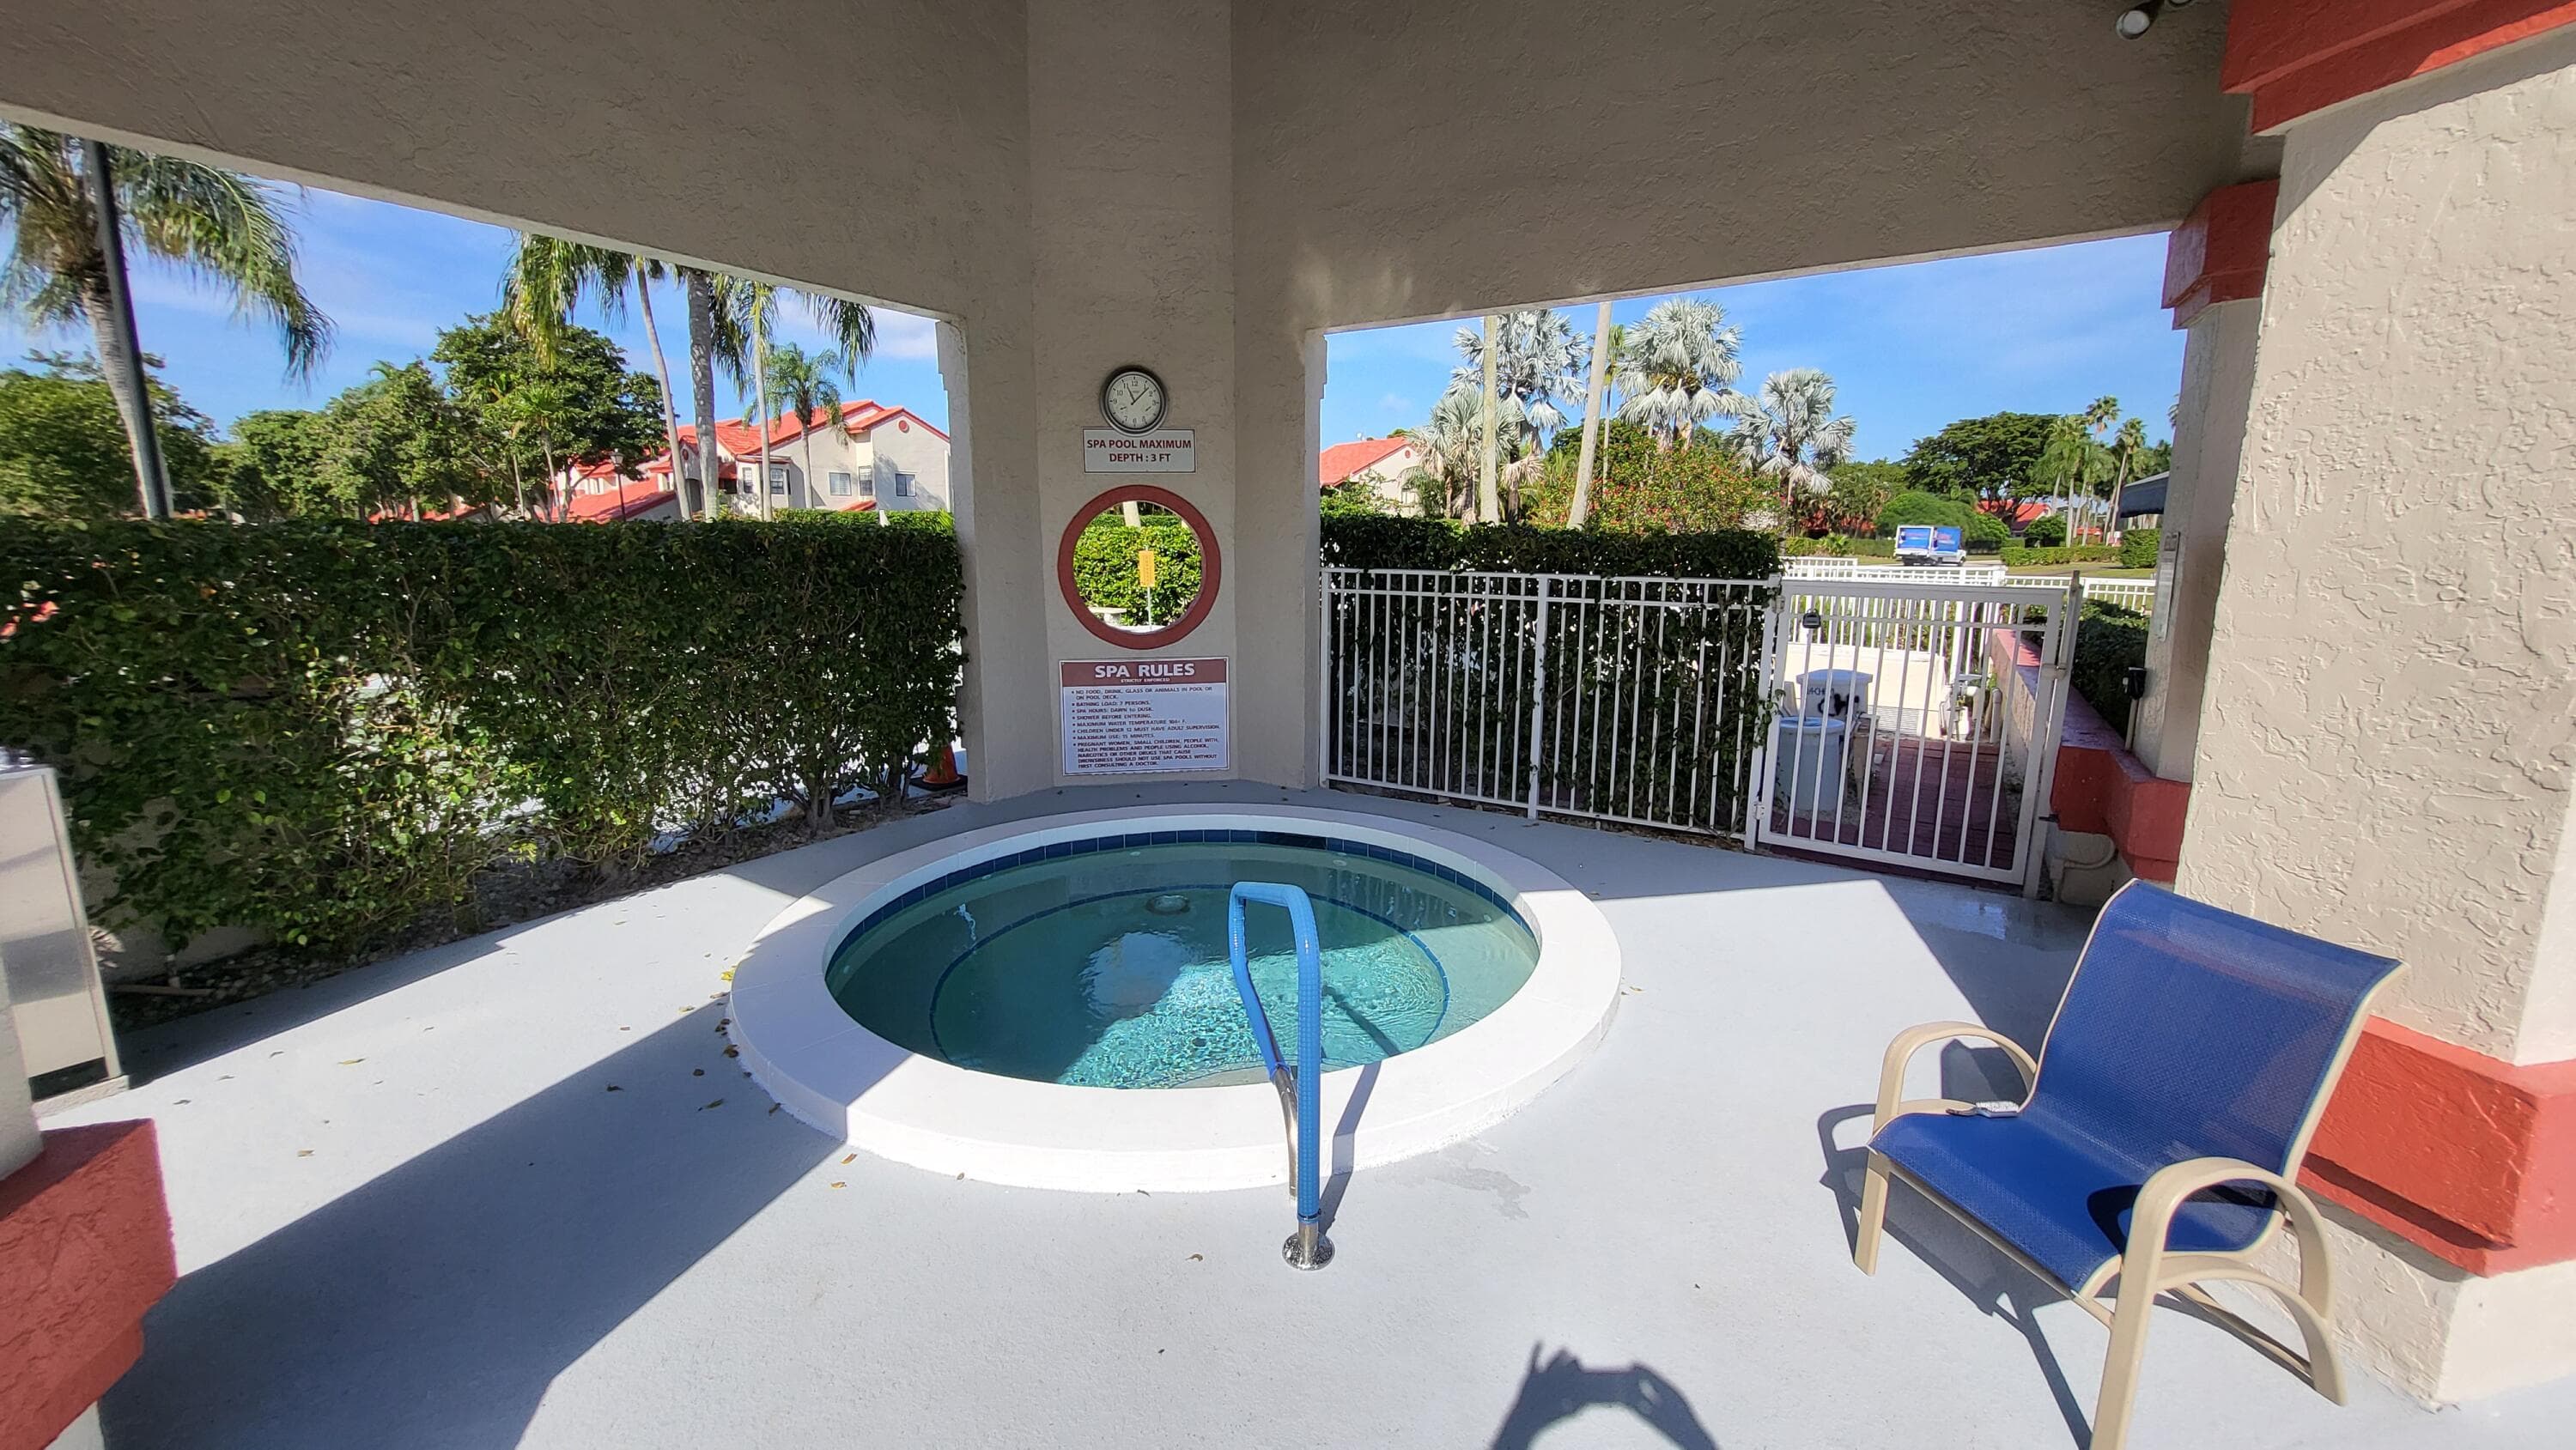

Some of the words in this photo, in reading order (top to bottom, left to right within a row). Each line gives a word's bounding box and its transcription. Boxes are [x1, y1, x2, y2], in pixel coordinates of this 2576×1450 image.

[1087, 440, 1106, 448] SPA
[1109, 440, 1137, 448] POOL
[1139, 440, 1191, 448] MAXIMUM
[1159, 453, 1171, 462] FT
[1095, 665, 1130, 677] SPA
[1139, 664, 1195, 676] RULES
